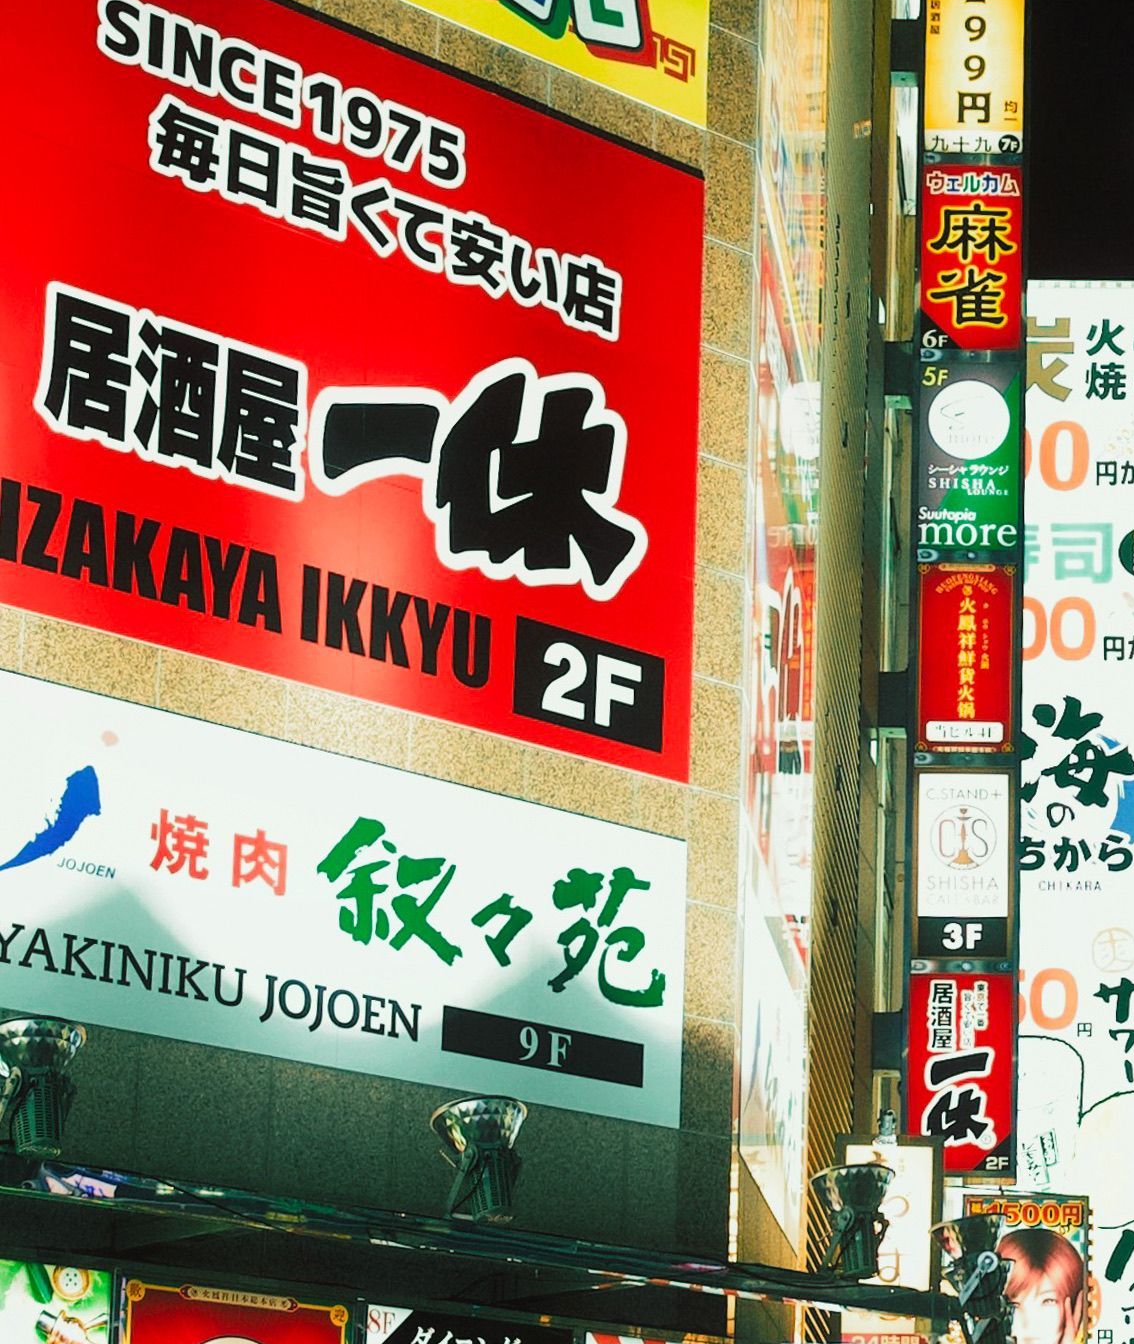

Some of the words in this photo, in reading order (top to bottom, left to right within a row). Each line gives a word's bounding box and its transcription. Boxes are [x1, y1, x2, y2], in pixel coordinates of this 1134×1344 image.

[930, 133, 994, 154] 九十九
[999, 136, 1019, 153] 7F
[925, 170, 1022, 198] ウェルカム
[154, 102, 622, 339] 毎日旨くて安い店
[927, 201, 1016, 328] 麻雀
[921, 328, 949, 349] 6F
[921, 366, 950, 388] 5F
[927, 477, 997, 491] SHISHA
[966, 488, 1010, 497] LOUNGE
[917, 506, 977, 524] Suutopia
[917, 521, 1018, 548] more
[0, 477, 283, 633] IZAKAYA
[300, 563, 494, 690] IKKYU
[541, 641, 645, 728] 2F
[1019, 834, 1134, 873] ちから
[56, 856, 117, 881] JOJOEN
[925, 874, 1001, 892] SHISHA
[1038, 880, 1103, 893] CHIKARA
[149, 806, 290, 898] 焼肉
[315, 815, 668, 1010] 叙々苑
[941, 921, 985, 951] 3F
[0, 921, 247, 1009] YAKINIKU
[259, 972, 424, 1044] JOJOEN
[517, 1024, 574, 1071] 9F
[984, 1155, 1010, 1171] 2F
[366, 1307, 397, 1336] 8F
